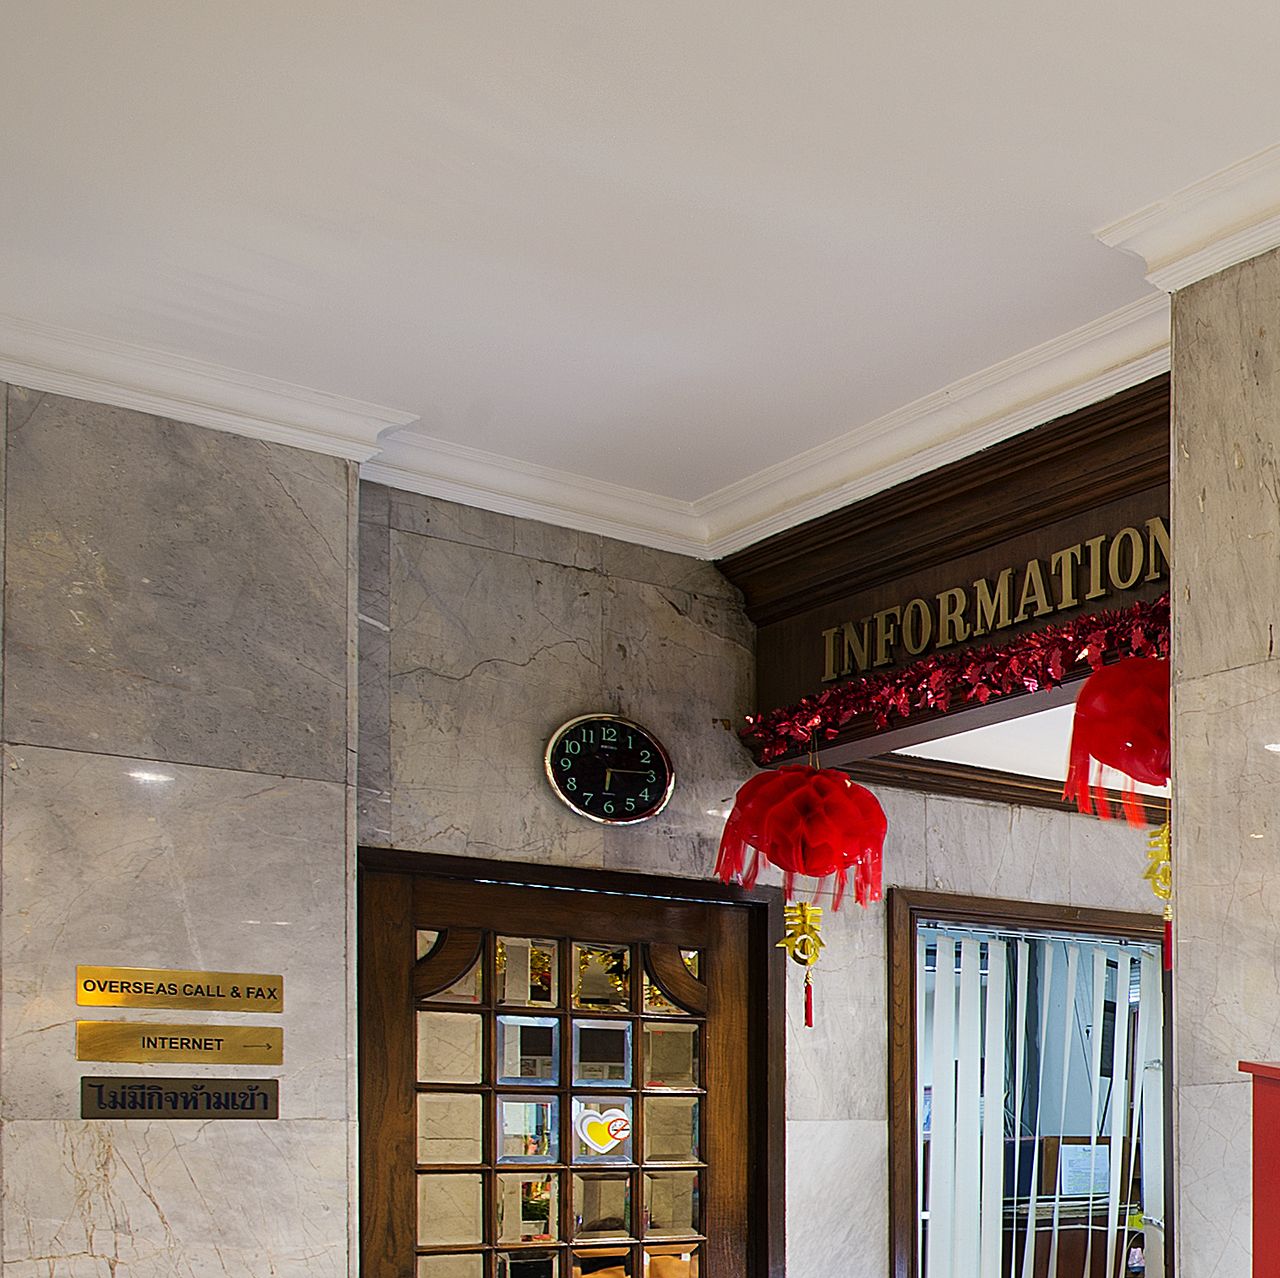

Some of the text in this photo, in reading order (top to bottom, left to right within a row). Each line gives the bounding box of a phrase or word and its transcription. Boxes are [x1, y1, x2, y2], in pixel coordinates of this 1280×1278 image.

[582, 729, 594, 743] 11
[601, 727, 616, 741] 12
[565, 740, 581, 755] 10
[627, 736, 633, 749] 1
[640, 750, 651, 763] 2
[560, 758, 571, 771] 9
[646, 770, 656, 783] 3
[566, 777, 577, 791] 8
[582, 793, 594, 806] 7
[639, 788, 650, 801] 4
[603, 801, 614, 814] 6
[625, 798, 635, 811] 5
[83, 979, 278, 1000] OVERSEAS CALL & FAX
[141, 1036, 224, 1051] INTERNET
[88, 1083, 269, 1111] ไม่มีกิจห้ามเข้า
